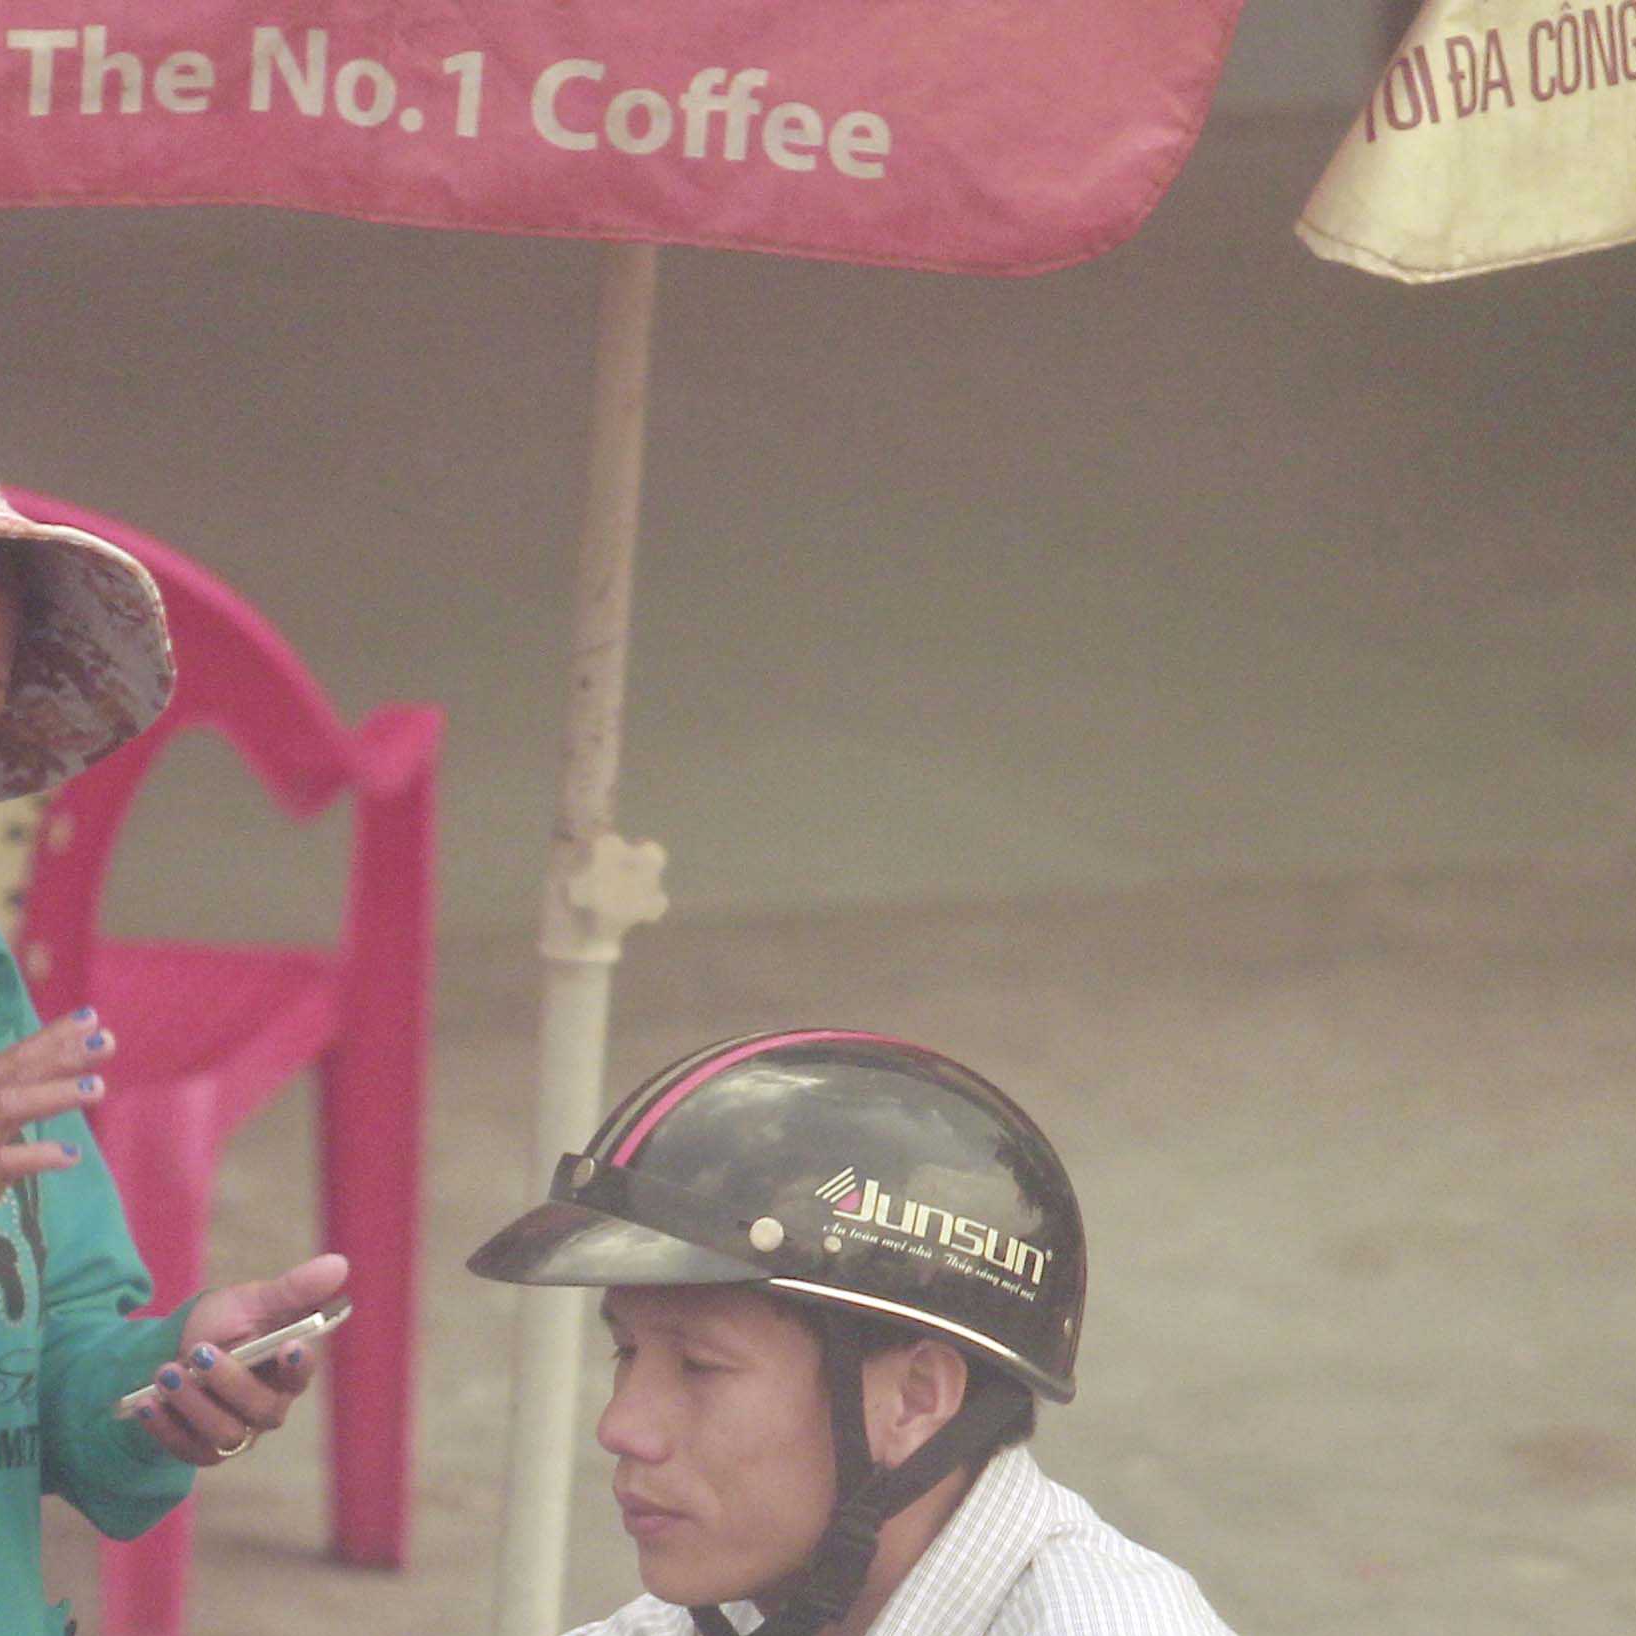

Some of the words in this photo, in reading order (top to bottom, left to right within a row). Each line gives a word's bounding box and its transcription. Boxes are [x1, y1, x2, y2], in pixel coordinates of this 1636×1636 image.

[6, 25, 216, 118] The
[249, 26, 485, 138] No.1
[529, 57, 893, 181] Coffee
[1445, 28, 1516, 119] ĐA
